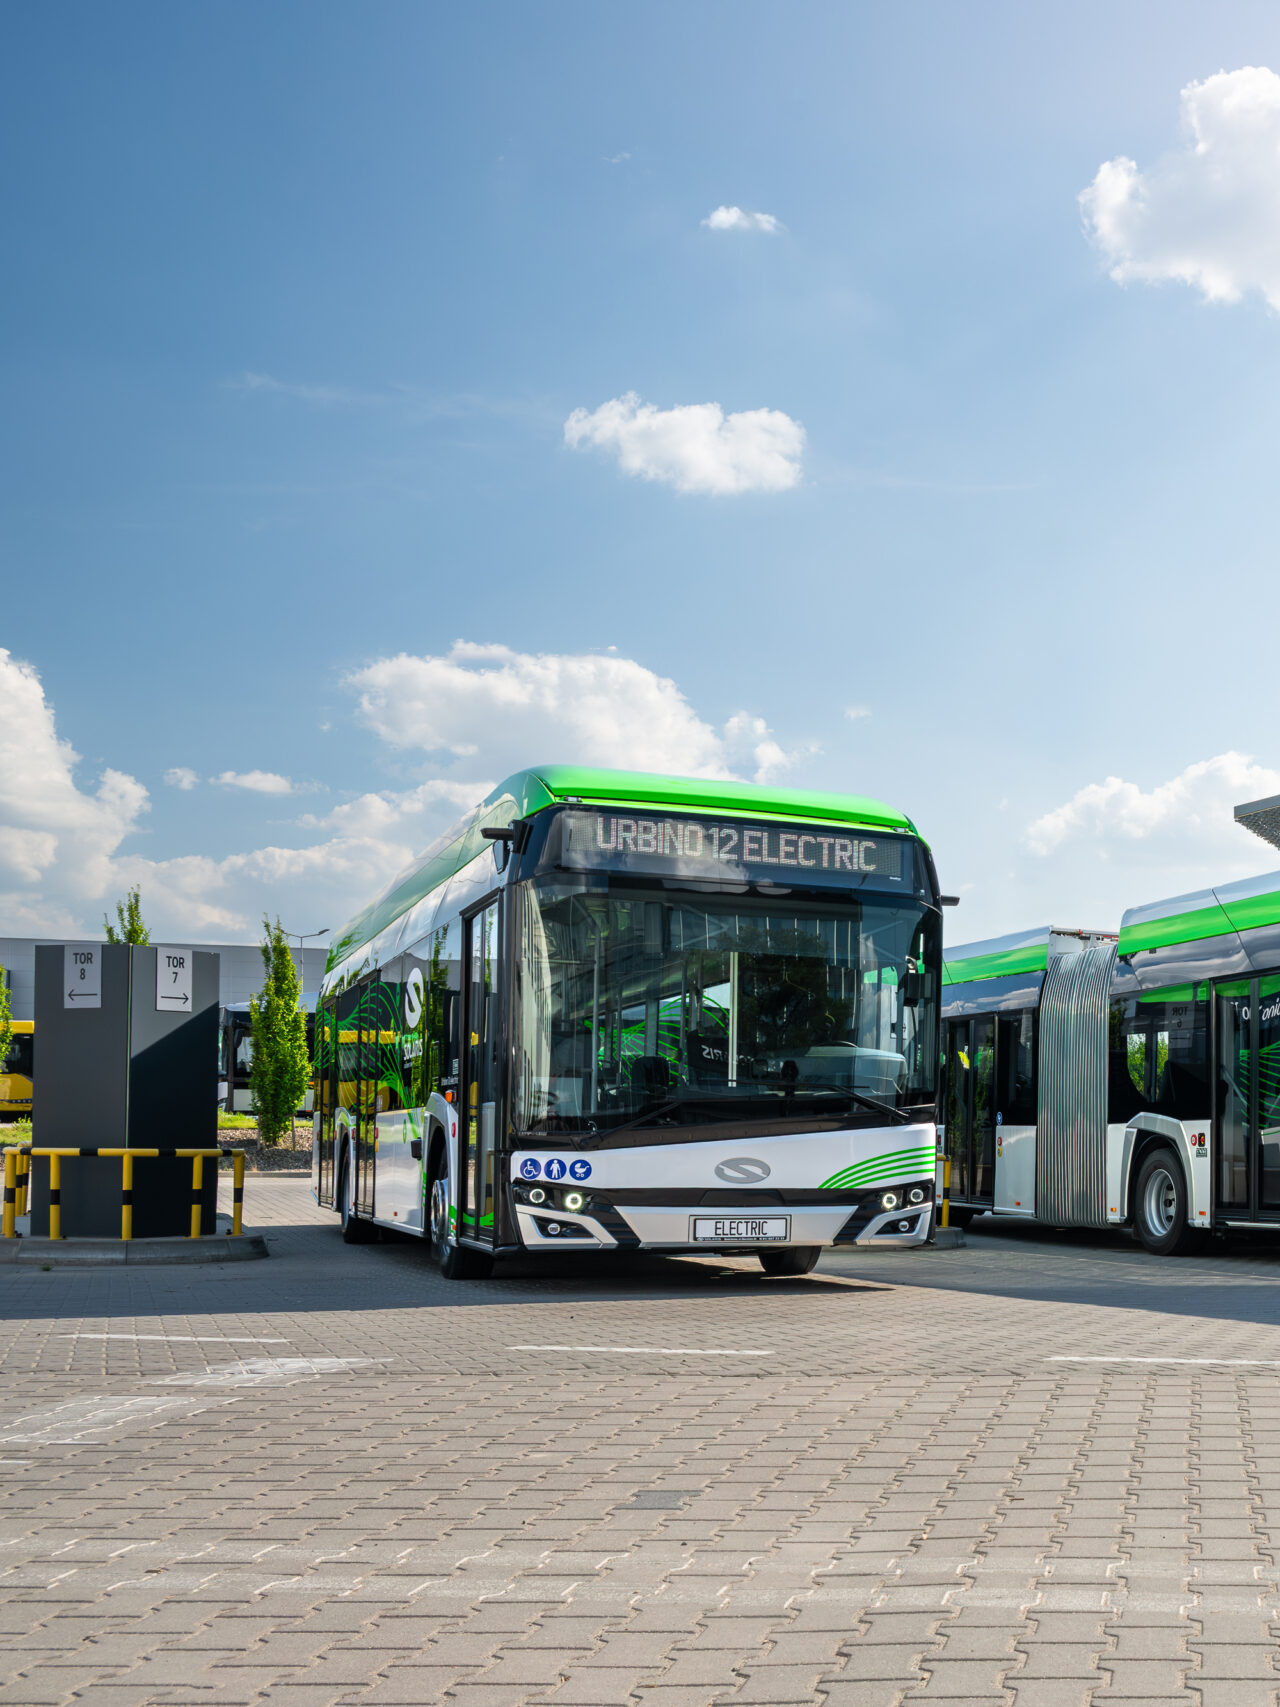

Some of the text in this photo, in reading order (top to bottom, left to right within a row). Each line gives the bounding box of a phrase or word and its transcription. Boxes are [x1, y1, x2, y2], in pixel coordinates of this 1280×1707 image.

[597, 817, 877, 871] URBINO 12 ELECTRIC
[73, 952, 94, 965] TOR
[166, 955, 185, 969] TOR
[79, 967, 86, 980] 8
[172, 971, 179, 983] 7
[714, 1220, 768, 1236] ELECTRIC
